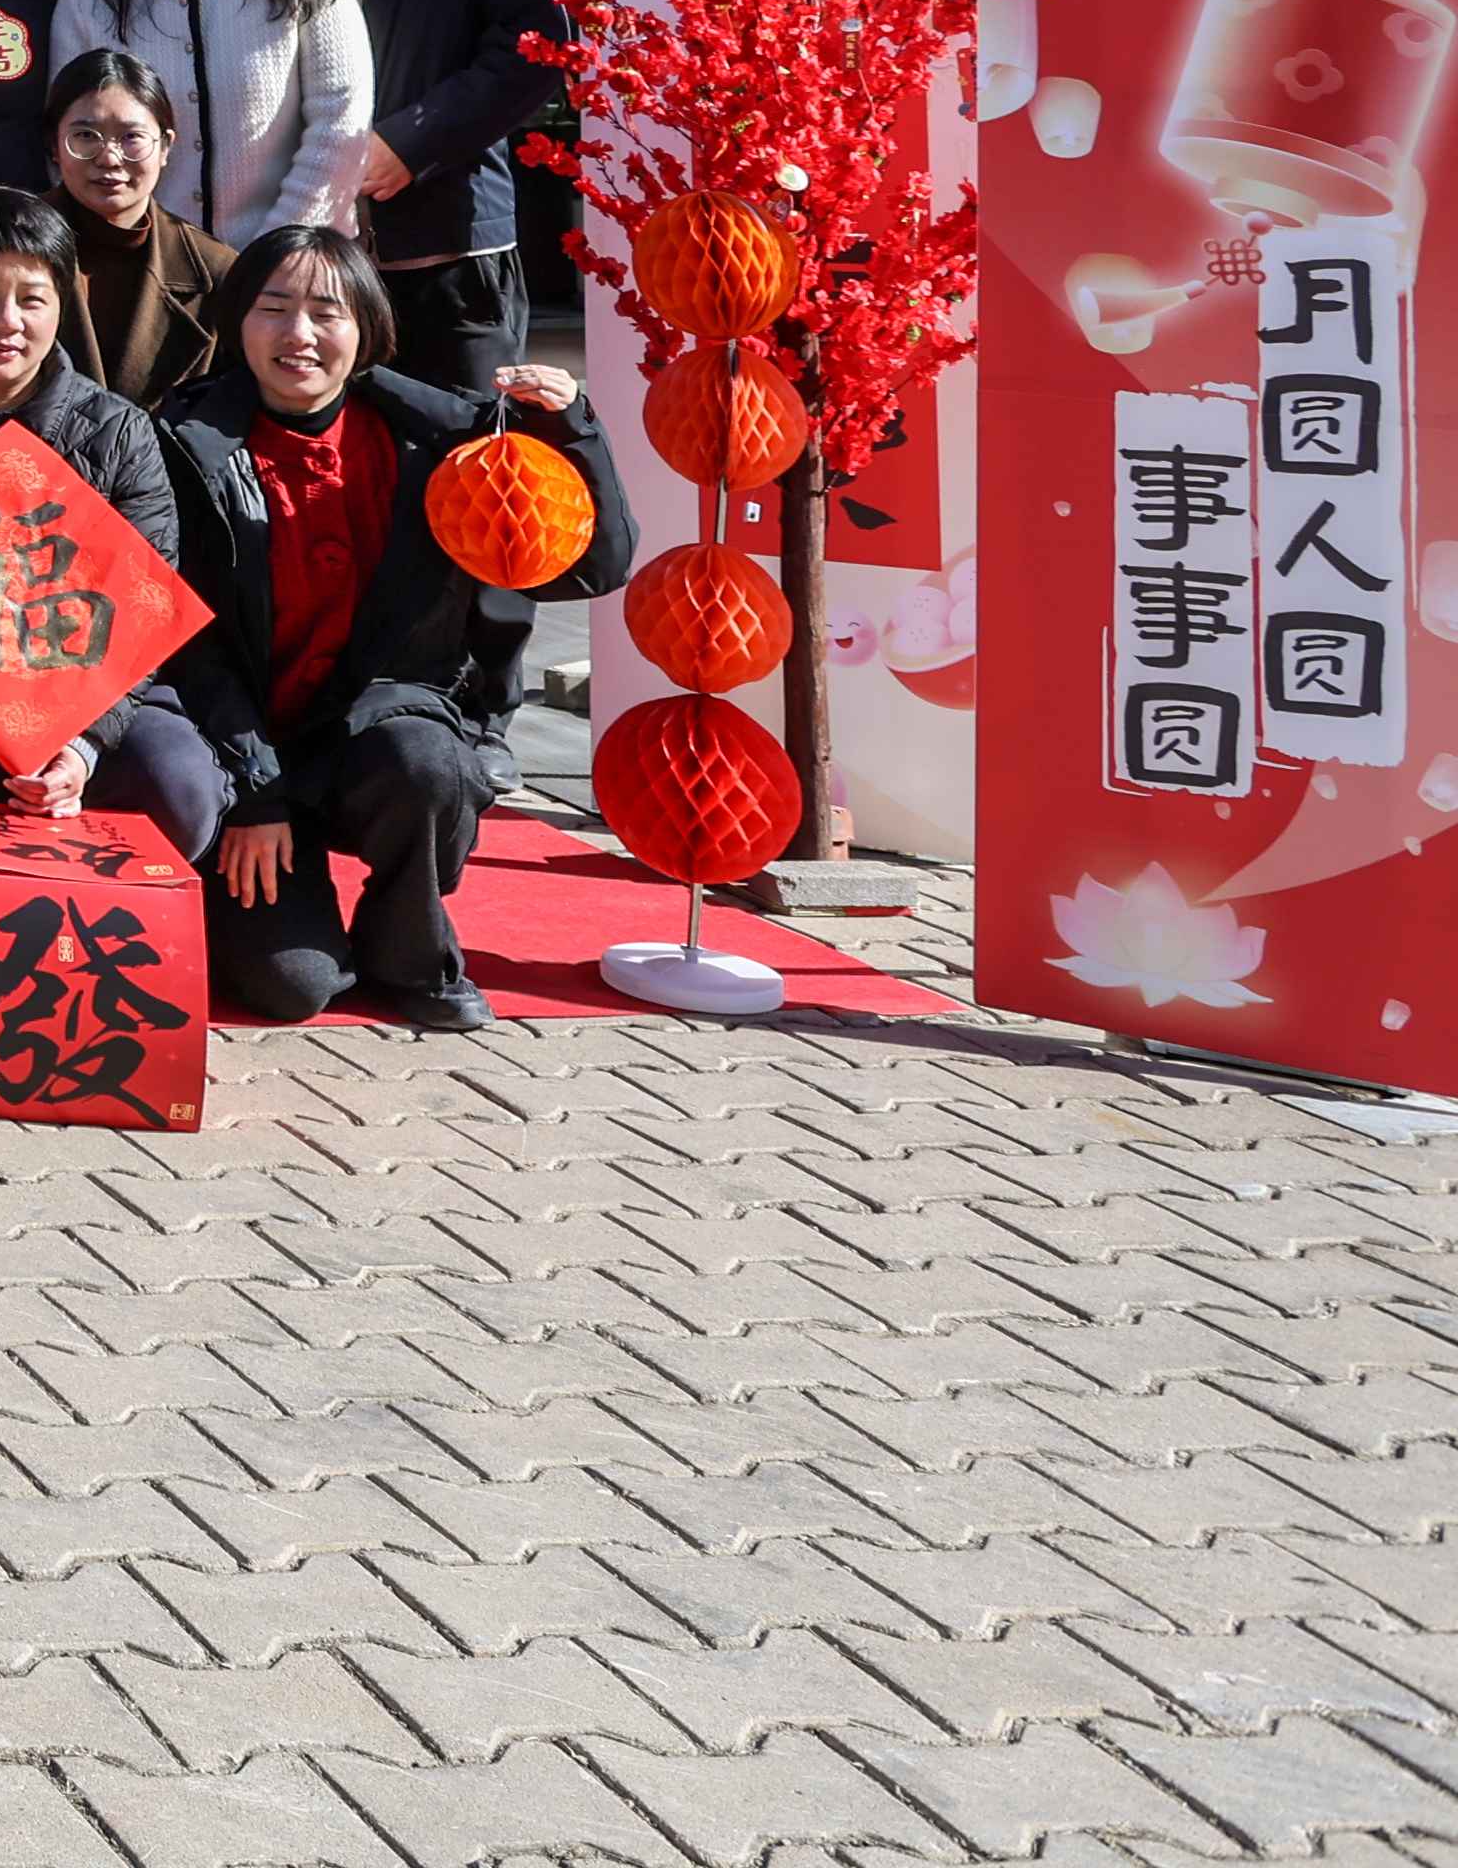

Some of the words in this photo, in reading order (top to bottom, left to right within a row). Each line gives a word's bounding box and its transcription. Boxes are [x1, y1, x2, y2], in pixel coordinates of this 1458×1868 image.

[1119, 443, 1250, 788] 事事圆
[1256, 258, 1394, 719] 月圆人圆
